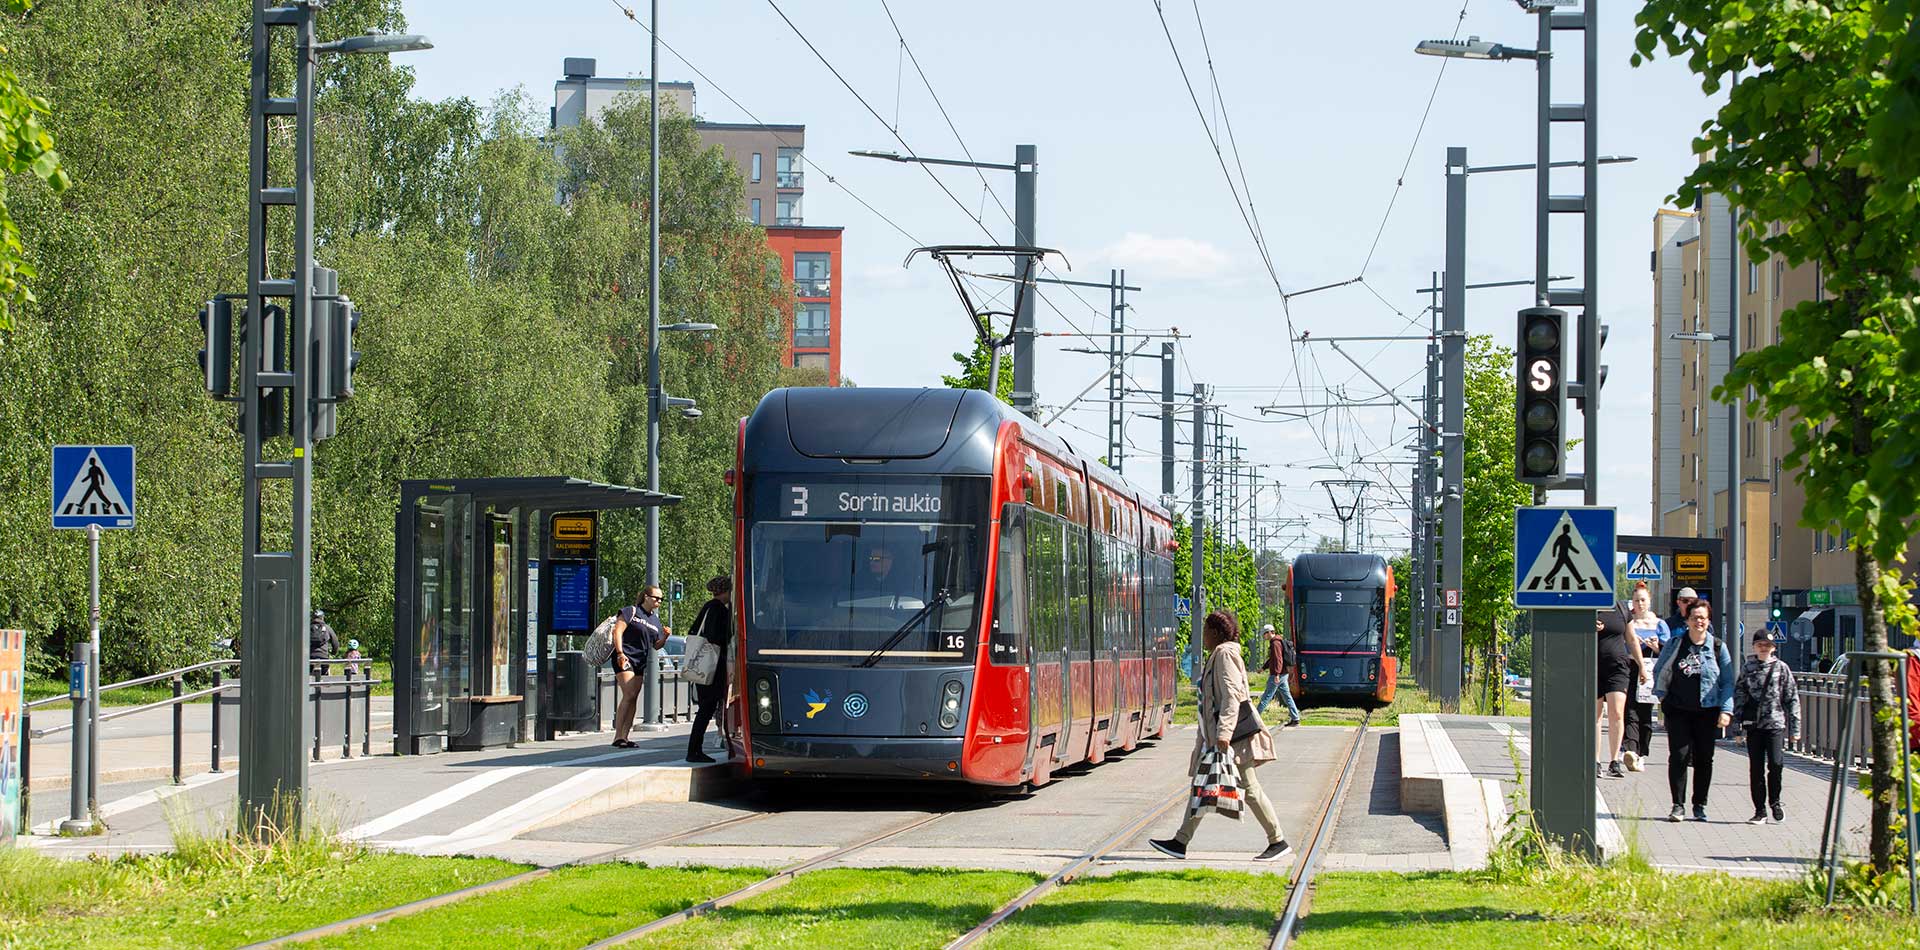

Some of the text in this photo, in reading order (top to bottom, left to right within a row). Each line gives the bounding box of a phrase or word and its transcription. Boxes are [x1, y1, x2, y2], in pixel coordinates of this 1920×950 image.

[1531, 360, 1552, 392] S
[791, 486, 942, 516] 3 Sorin aukio
[1335, 592, 1343, 602] 3
[1448, 596, 1455, 604] 2
[1448, 612, 1455, 621] 4
[946, 635, 965, 649] 16
